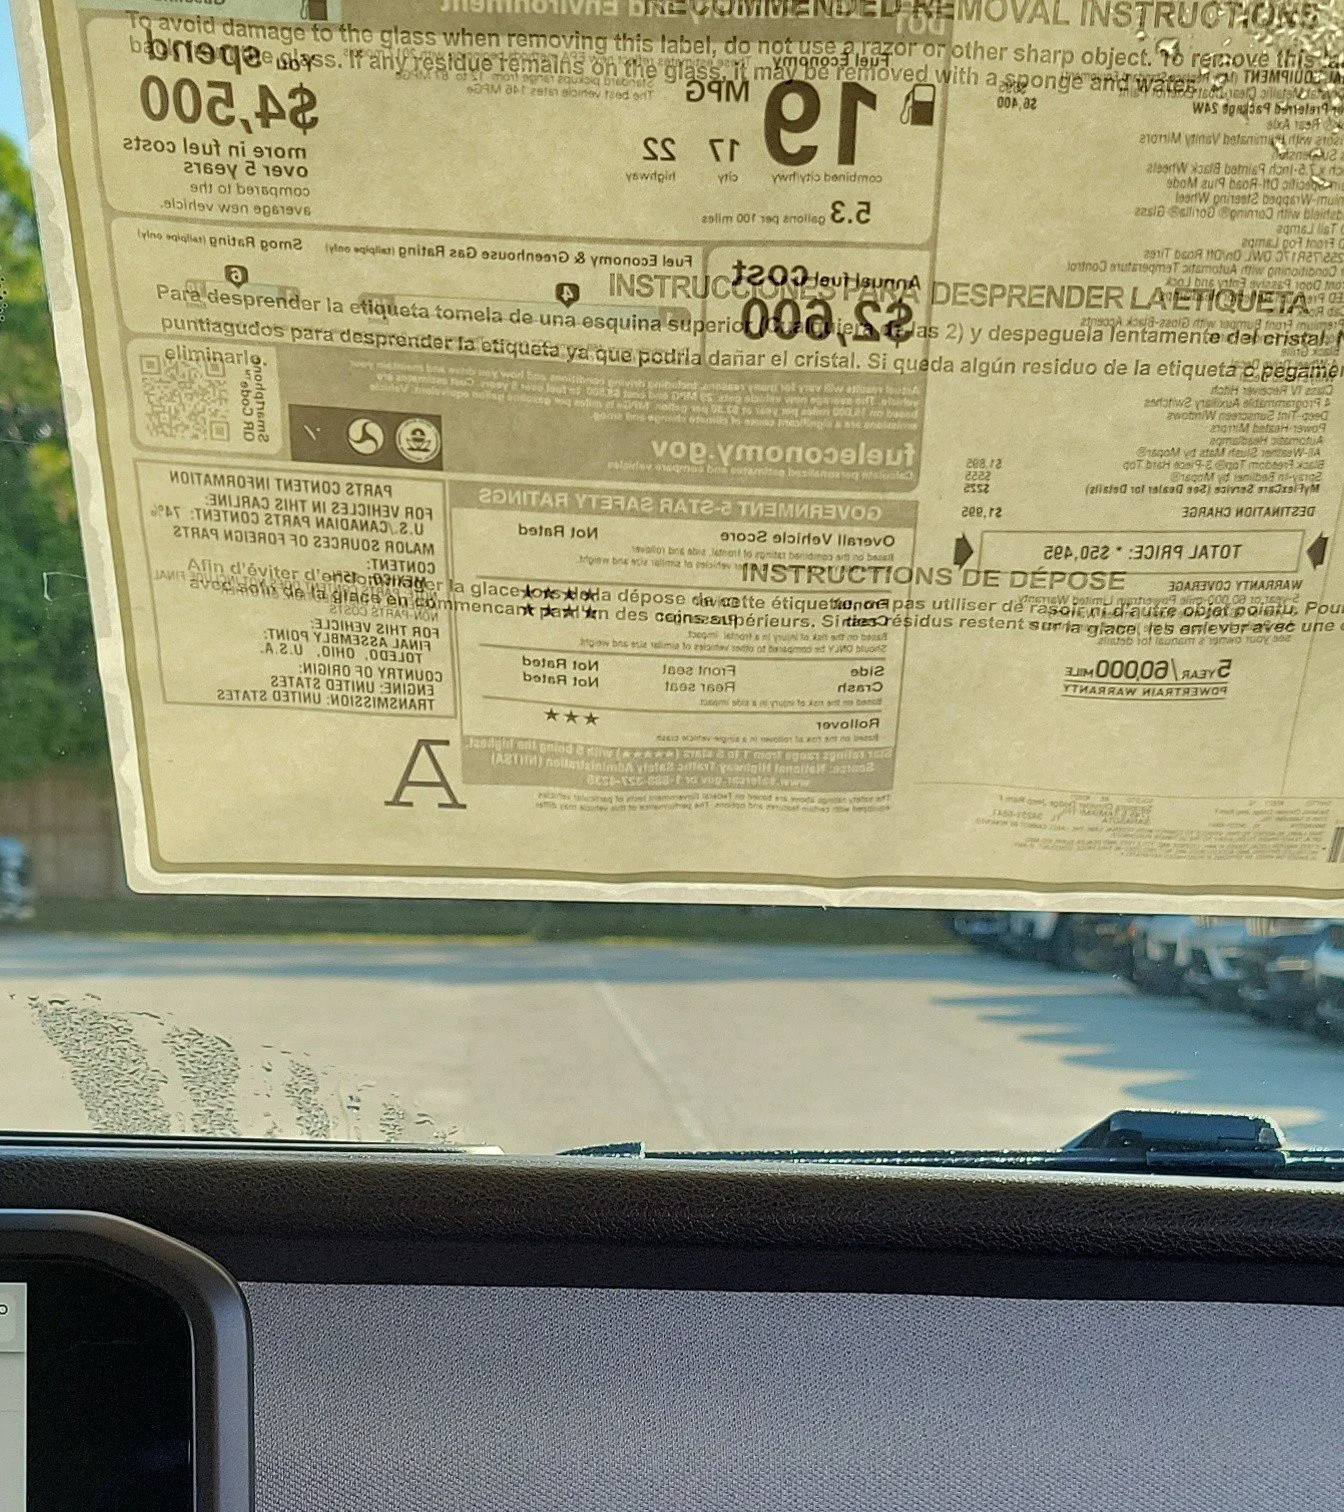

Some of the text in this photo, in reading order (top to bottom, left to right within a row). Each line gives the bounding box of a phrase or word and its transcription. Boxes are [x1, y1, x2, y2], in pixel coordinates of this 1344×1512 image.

[125, 10, 1152, 75] To avoid damage to the glass when removing this label, do not use a razor or other sharp object.
[931, 281, 1125, 310] DESPRENDER
[1130, 287, 1166, 310] LA
[742, 563, 953, 586] INSTRUCTIONS
[962, 569, 1000, 588] DE
[1009, 567, 1126, 591] DÉPOSE
